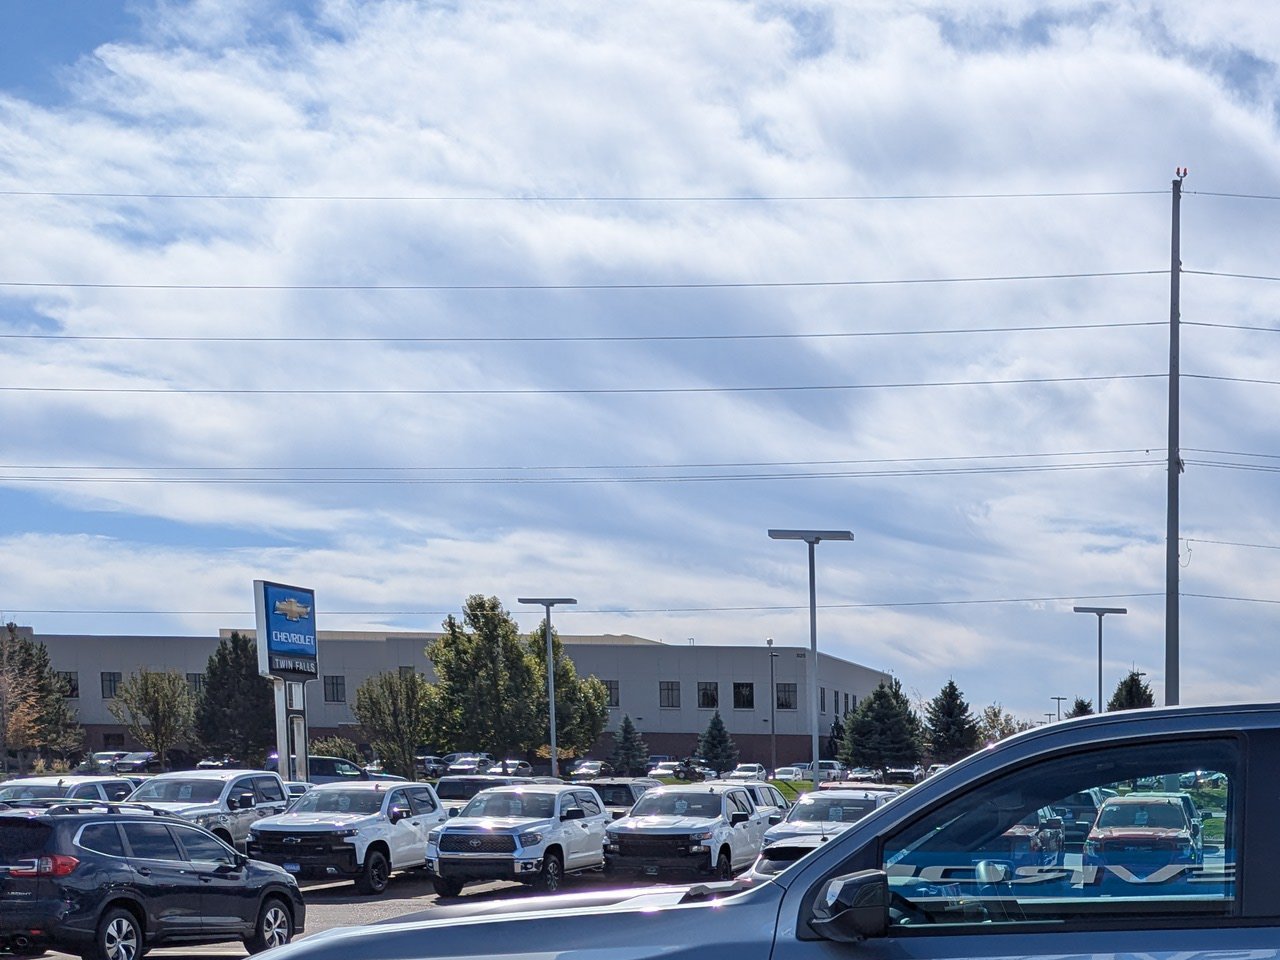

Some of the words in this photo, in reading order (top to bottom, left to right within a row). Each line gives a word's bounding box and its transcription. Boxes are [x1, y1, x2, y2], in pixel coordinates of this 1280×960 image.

[272, 631, 315, 645] CHEVROLET
[275, 659, 294, 670] TWIN
[295, 661, 316, 673] FALLS
